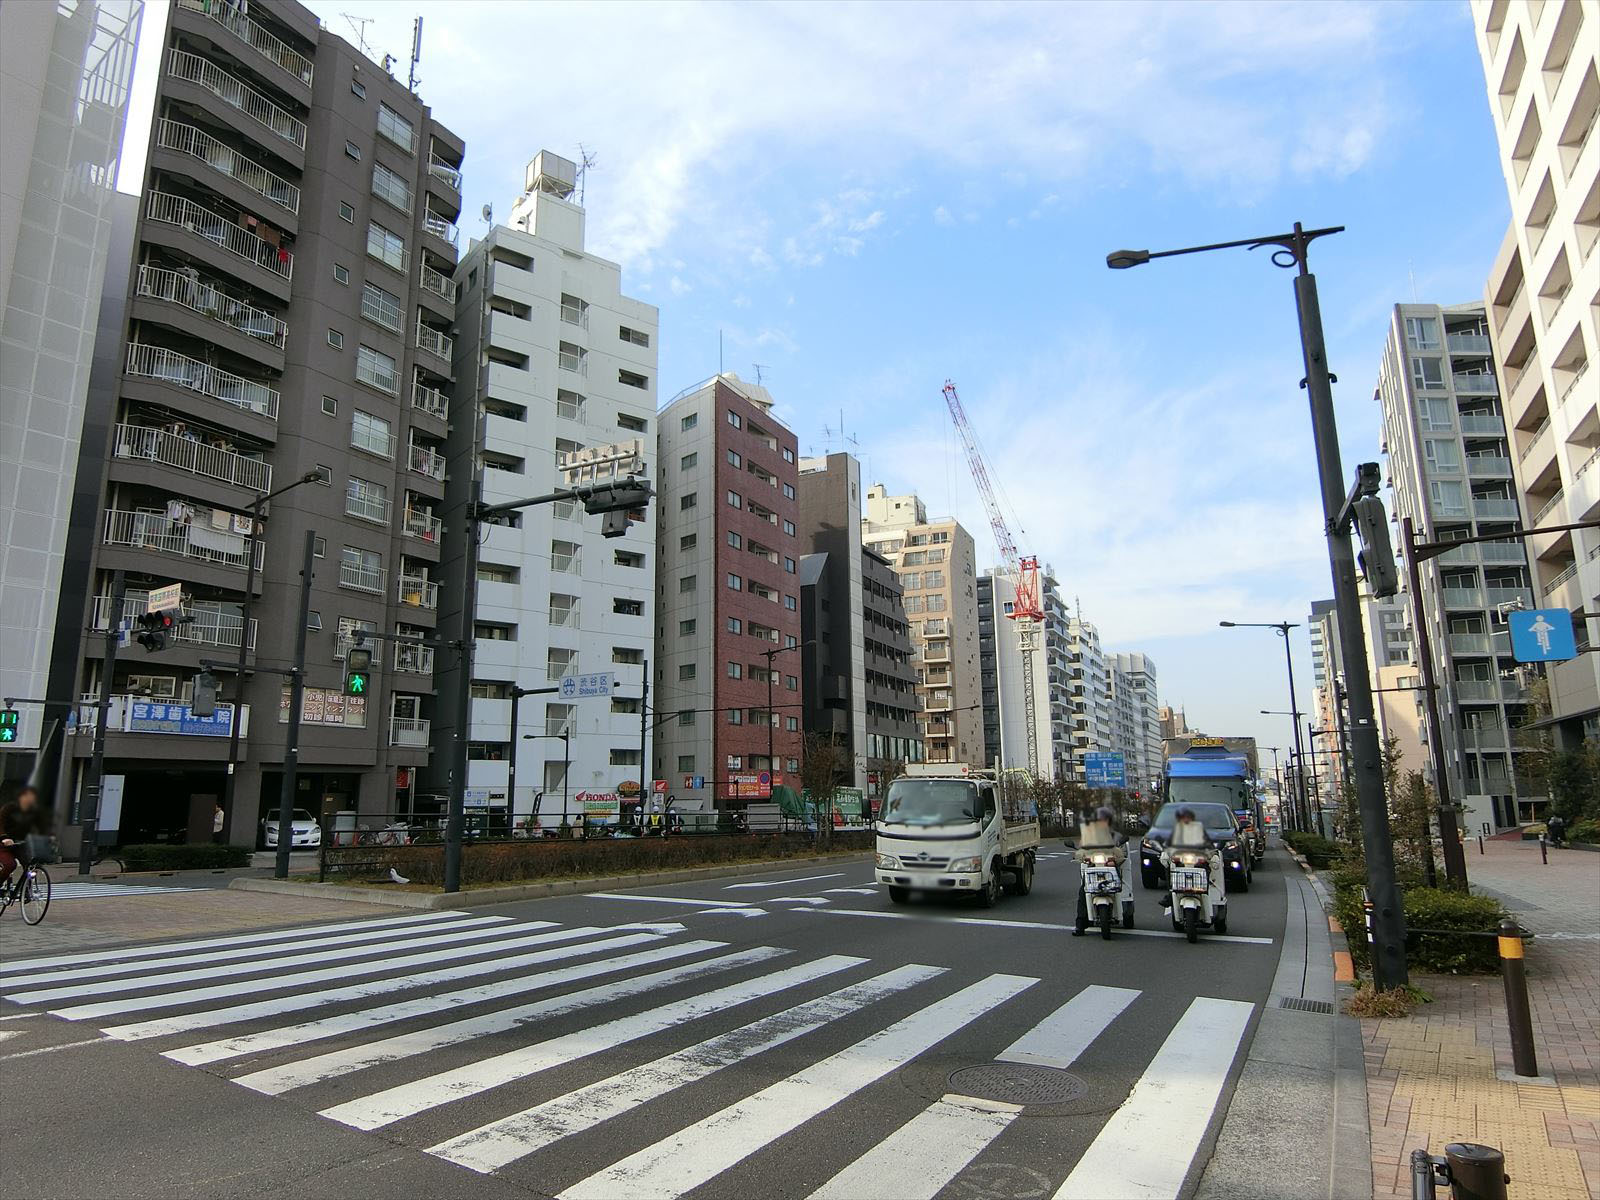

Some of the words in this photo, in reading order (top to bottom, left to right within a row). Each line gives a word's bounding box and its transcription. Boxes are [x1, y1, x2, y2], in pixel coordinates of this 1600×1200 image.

[580, 675, 607, 687] 渋谷区
[579, 687, 598, 696] Shibuya
[599, 686, 608, 695] City
[586, 793, 617, 801] HONDA
